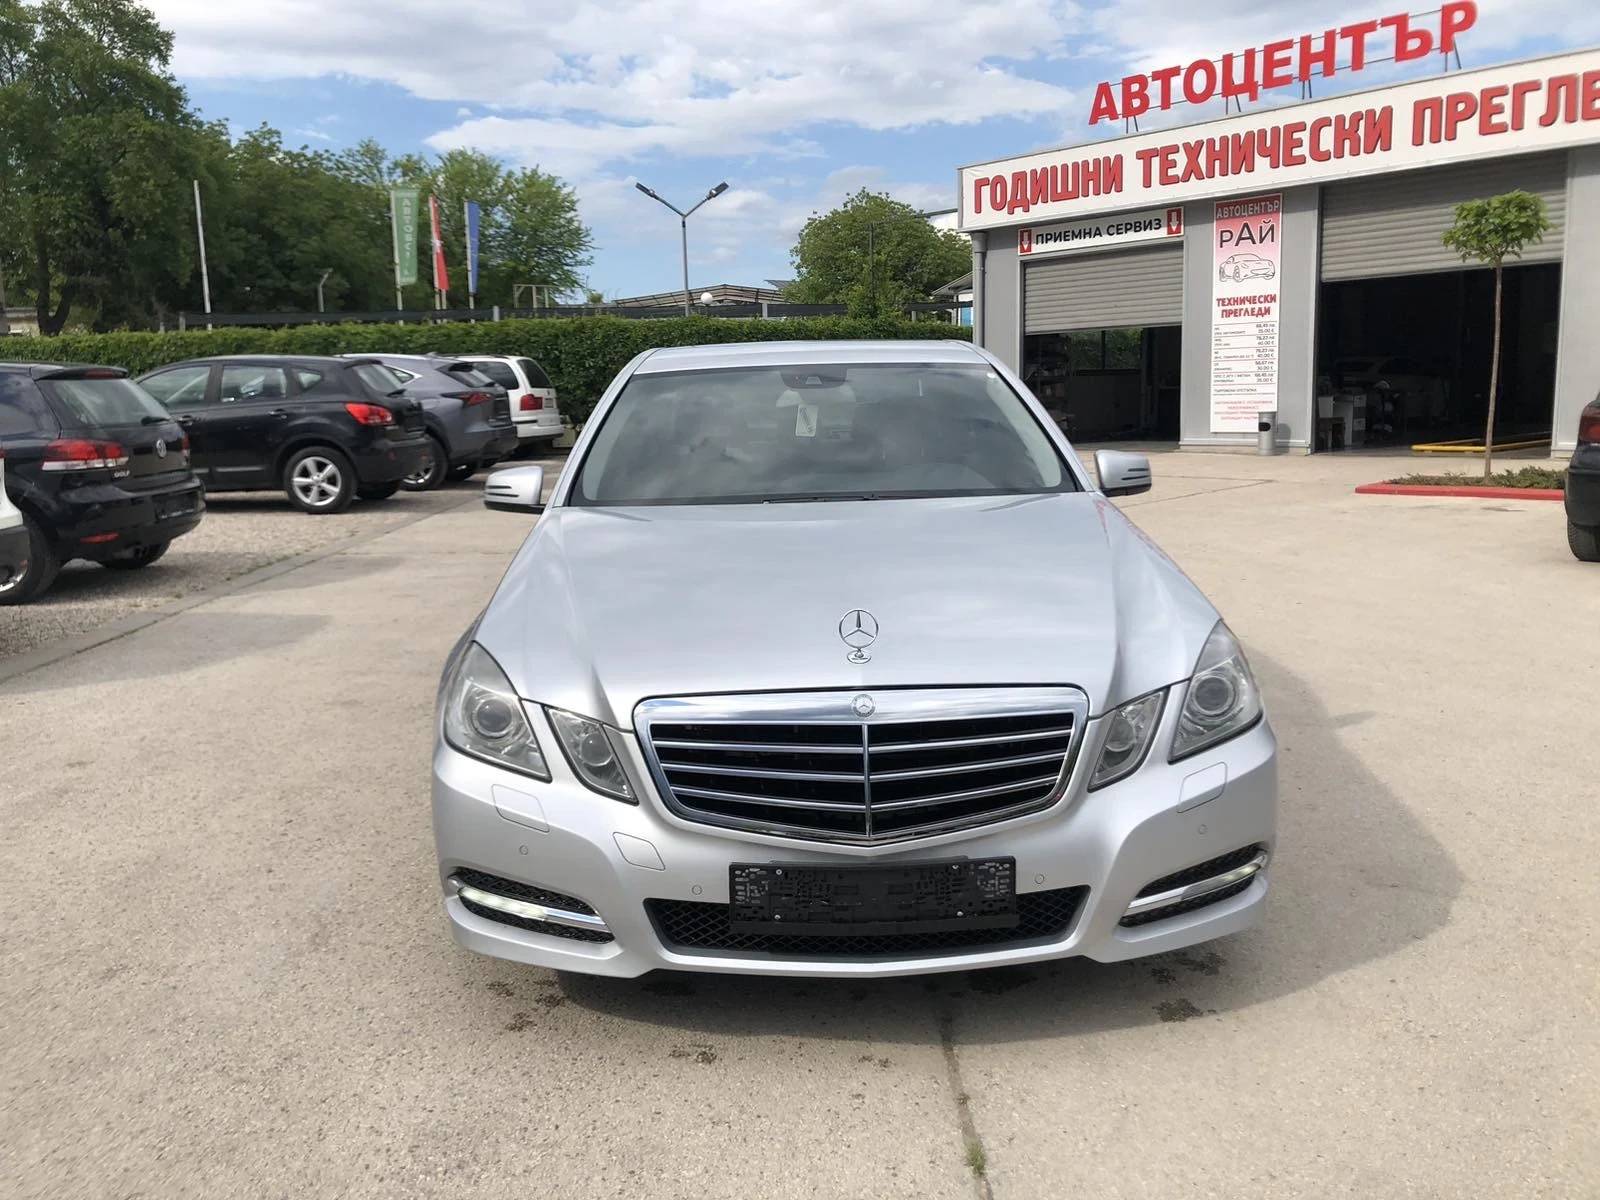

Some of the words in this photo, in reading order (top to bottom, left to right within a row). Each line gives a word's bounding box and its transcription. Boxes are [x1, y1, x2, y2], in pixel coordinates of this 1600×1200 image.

[1089, 0, 1478, 126] АВТОЦЕНТЪР
[974, 154, 1123, 214] ГОДИШНИ
[1136, 105, 1394, 189] ТЕХНИЧЕСКИ
[1412, 69, 1600, 146] ПРЕГЛЕ
[1217, 199, 1280, 219] АВТОЦЕНТЪР
[1036, 228, 1102, 245] ПРИЕМНА
[1106, 218, 1162, 236] СЕРВИЗ
[1219, 219, 1275, 248] РАЙ
[1216, 294, 1277, 307] ТЕХНИЧЕСКИ
[1221, 306, 1271, 318] ПРЕГЛЕДИ
